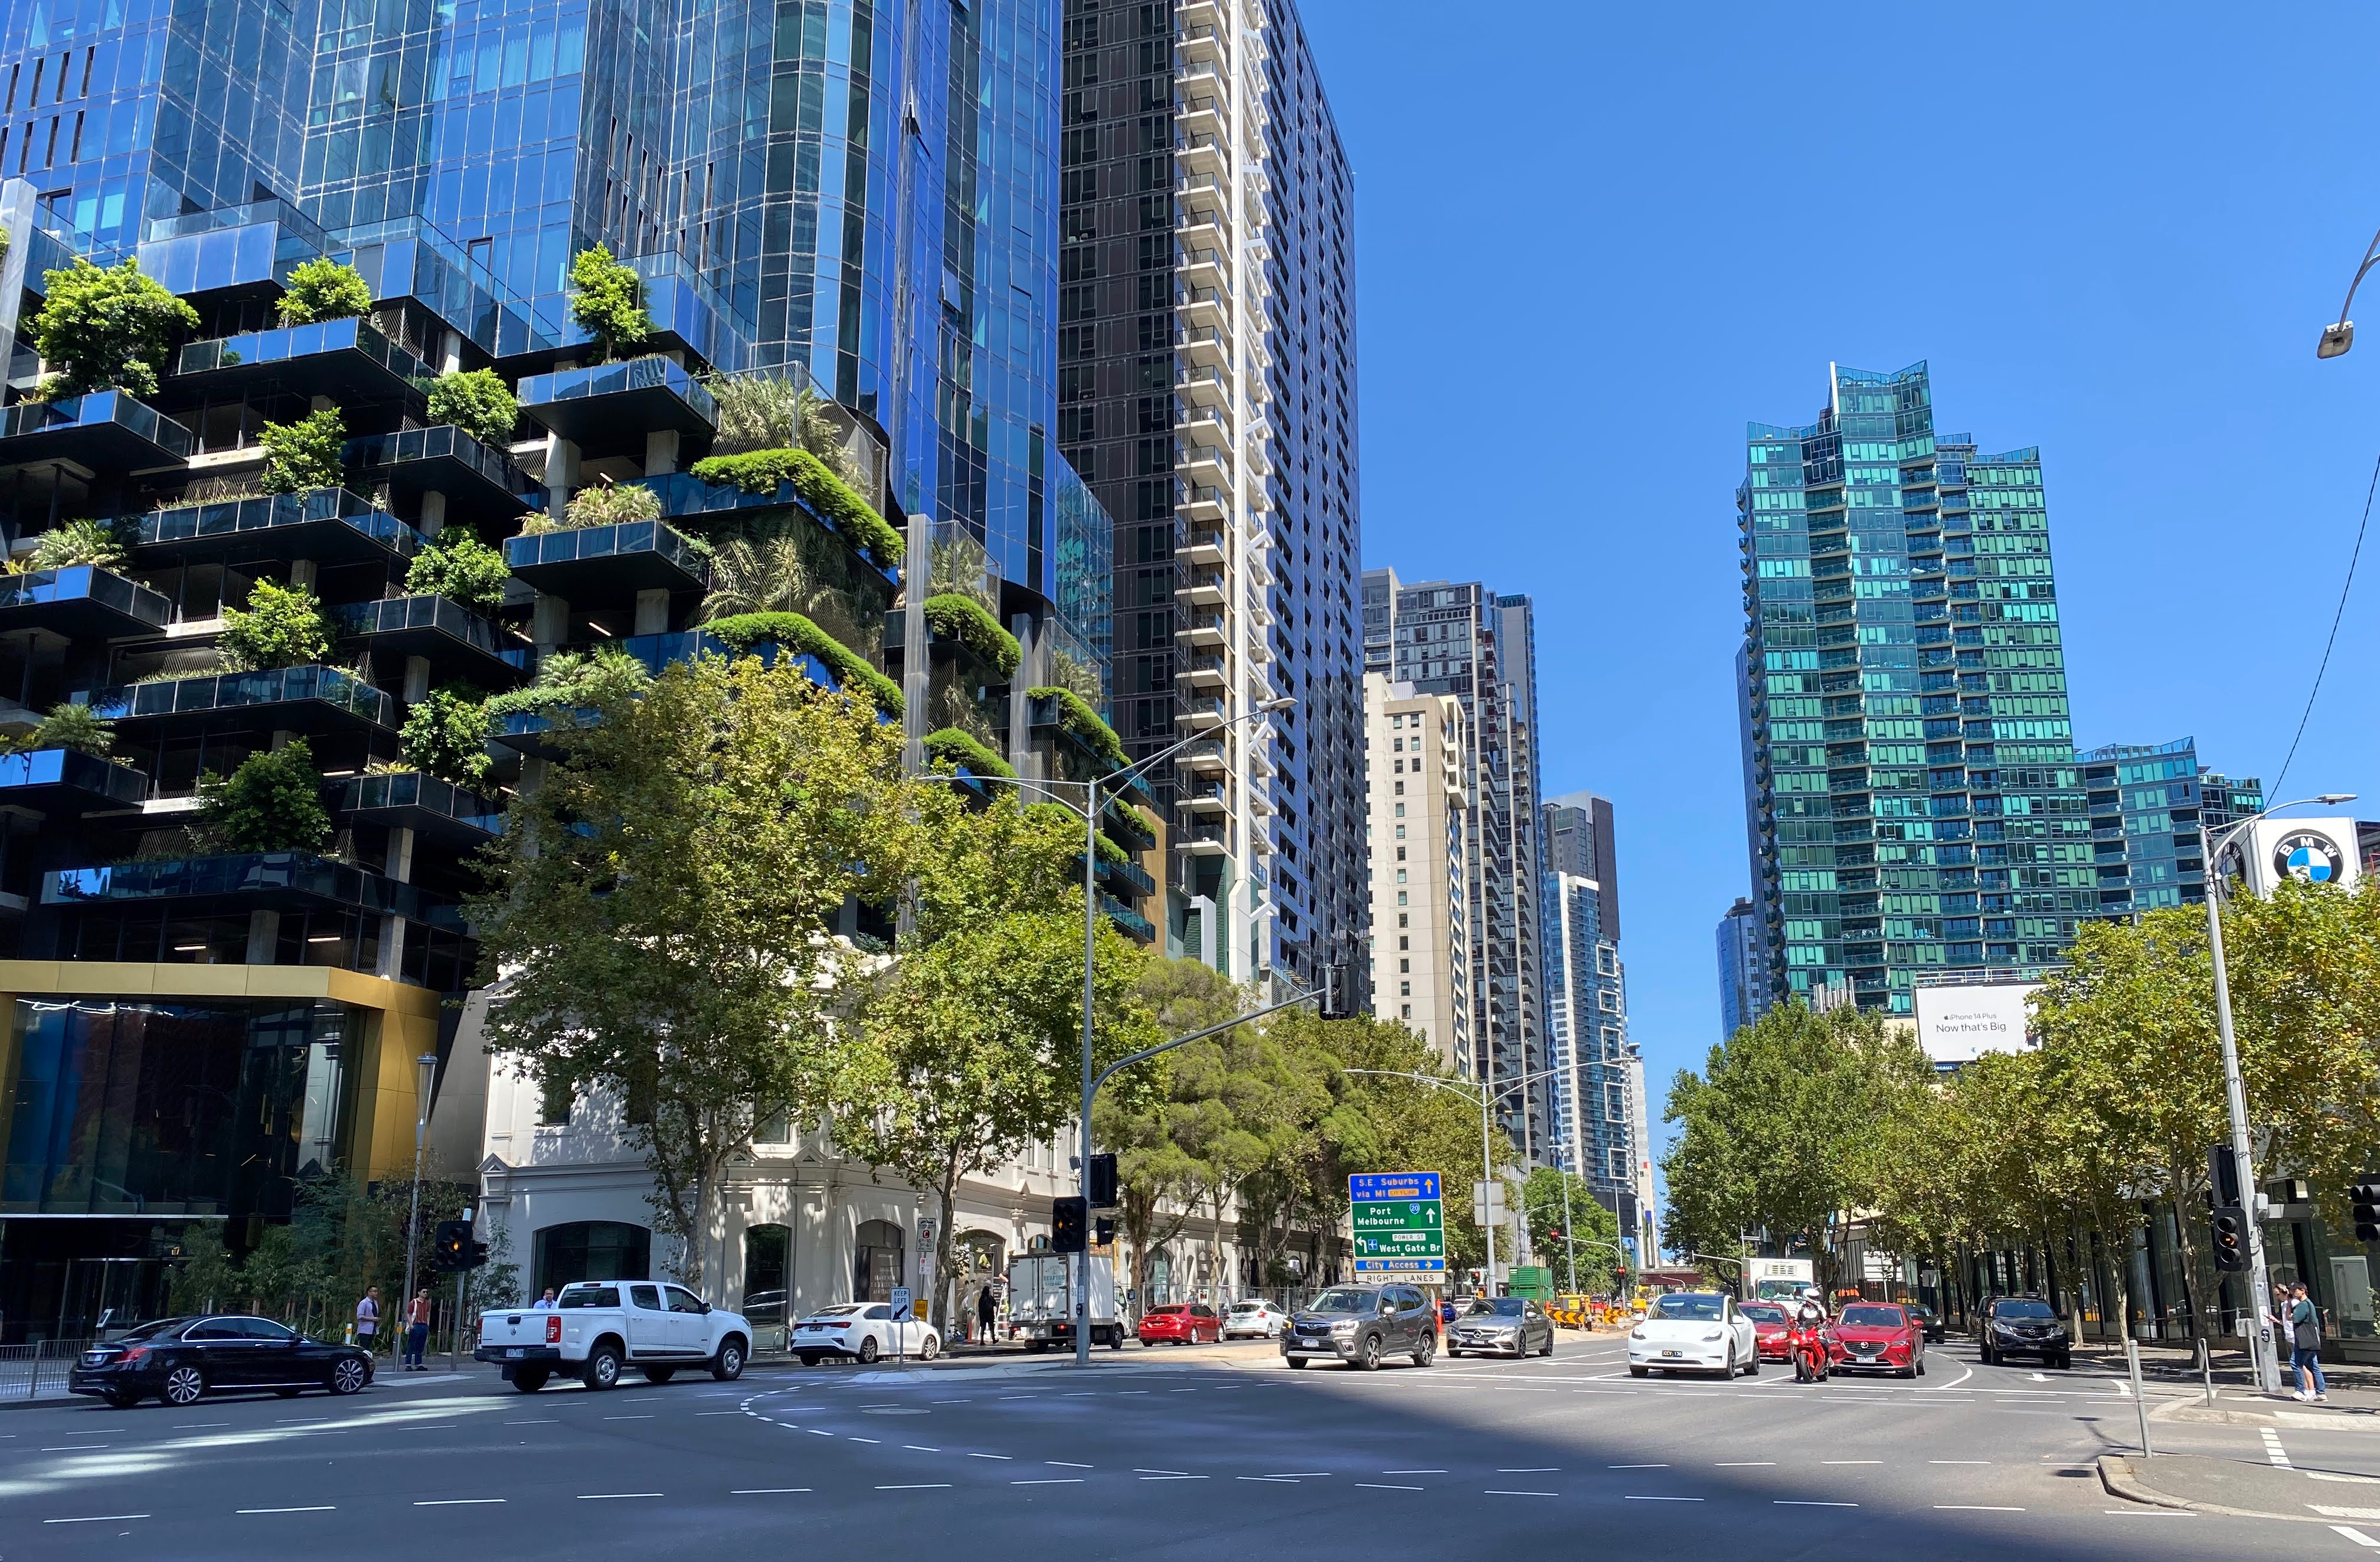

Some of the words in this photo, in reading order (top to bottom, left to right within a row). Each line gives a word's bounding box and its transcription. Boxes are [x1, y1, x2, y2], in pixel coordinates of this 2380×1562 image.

[2279, 836, 2338, 858] BMW
[1936, 1024, 1959, 1032] Now
[1961, 1022, 1988, 1031] that's
[1990, 1022, 2006, 1032] Big
[1359, 1178, 1376, 1187] S.E.
[1381, 1178, 1419, 1186] Suburbs
[1379, 1244, 1401, 1252] West
[1405, 1244, 1426, 1252] Gate
[1366, 1260, 1384, 1270] City
[1388, 1260, 1419, 1269] Access
